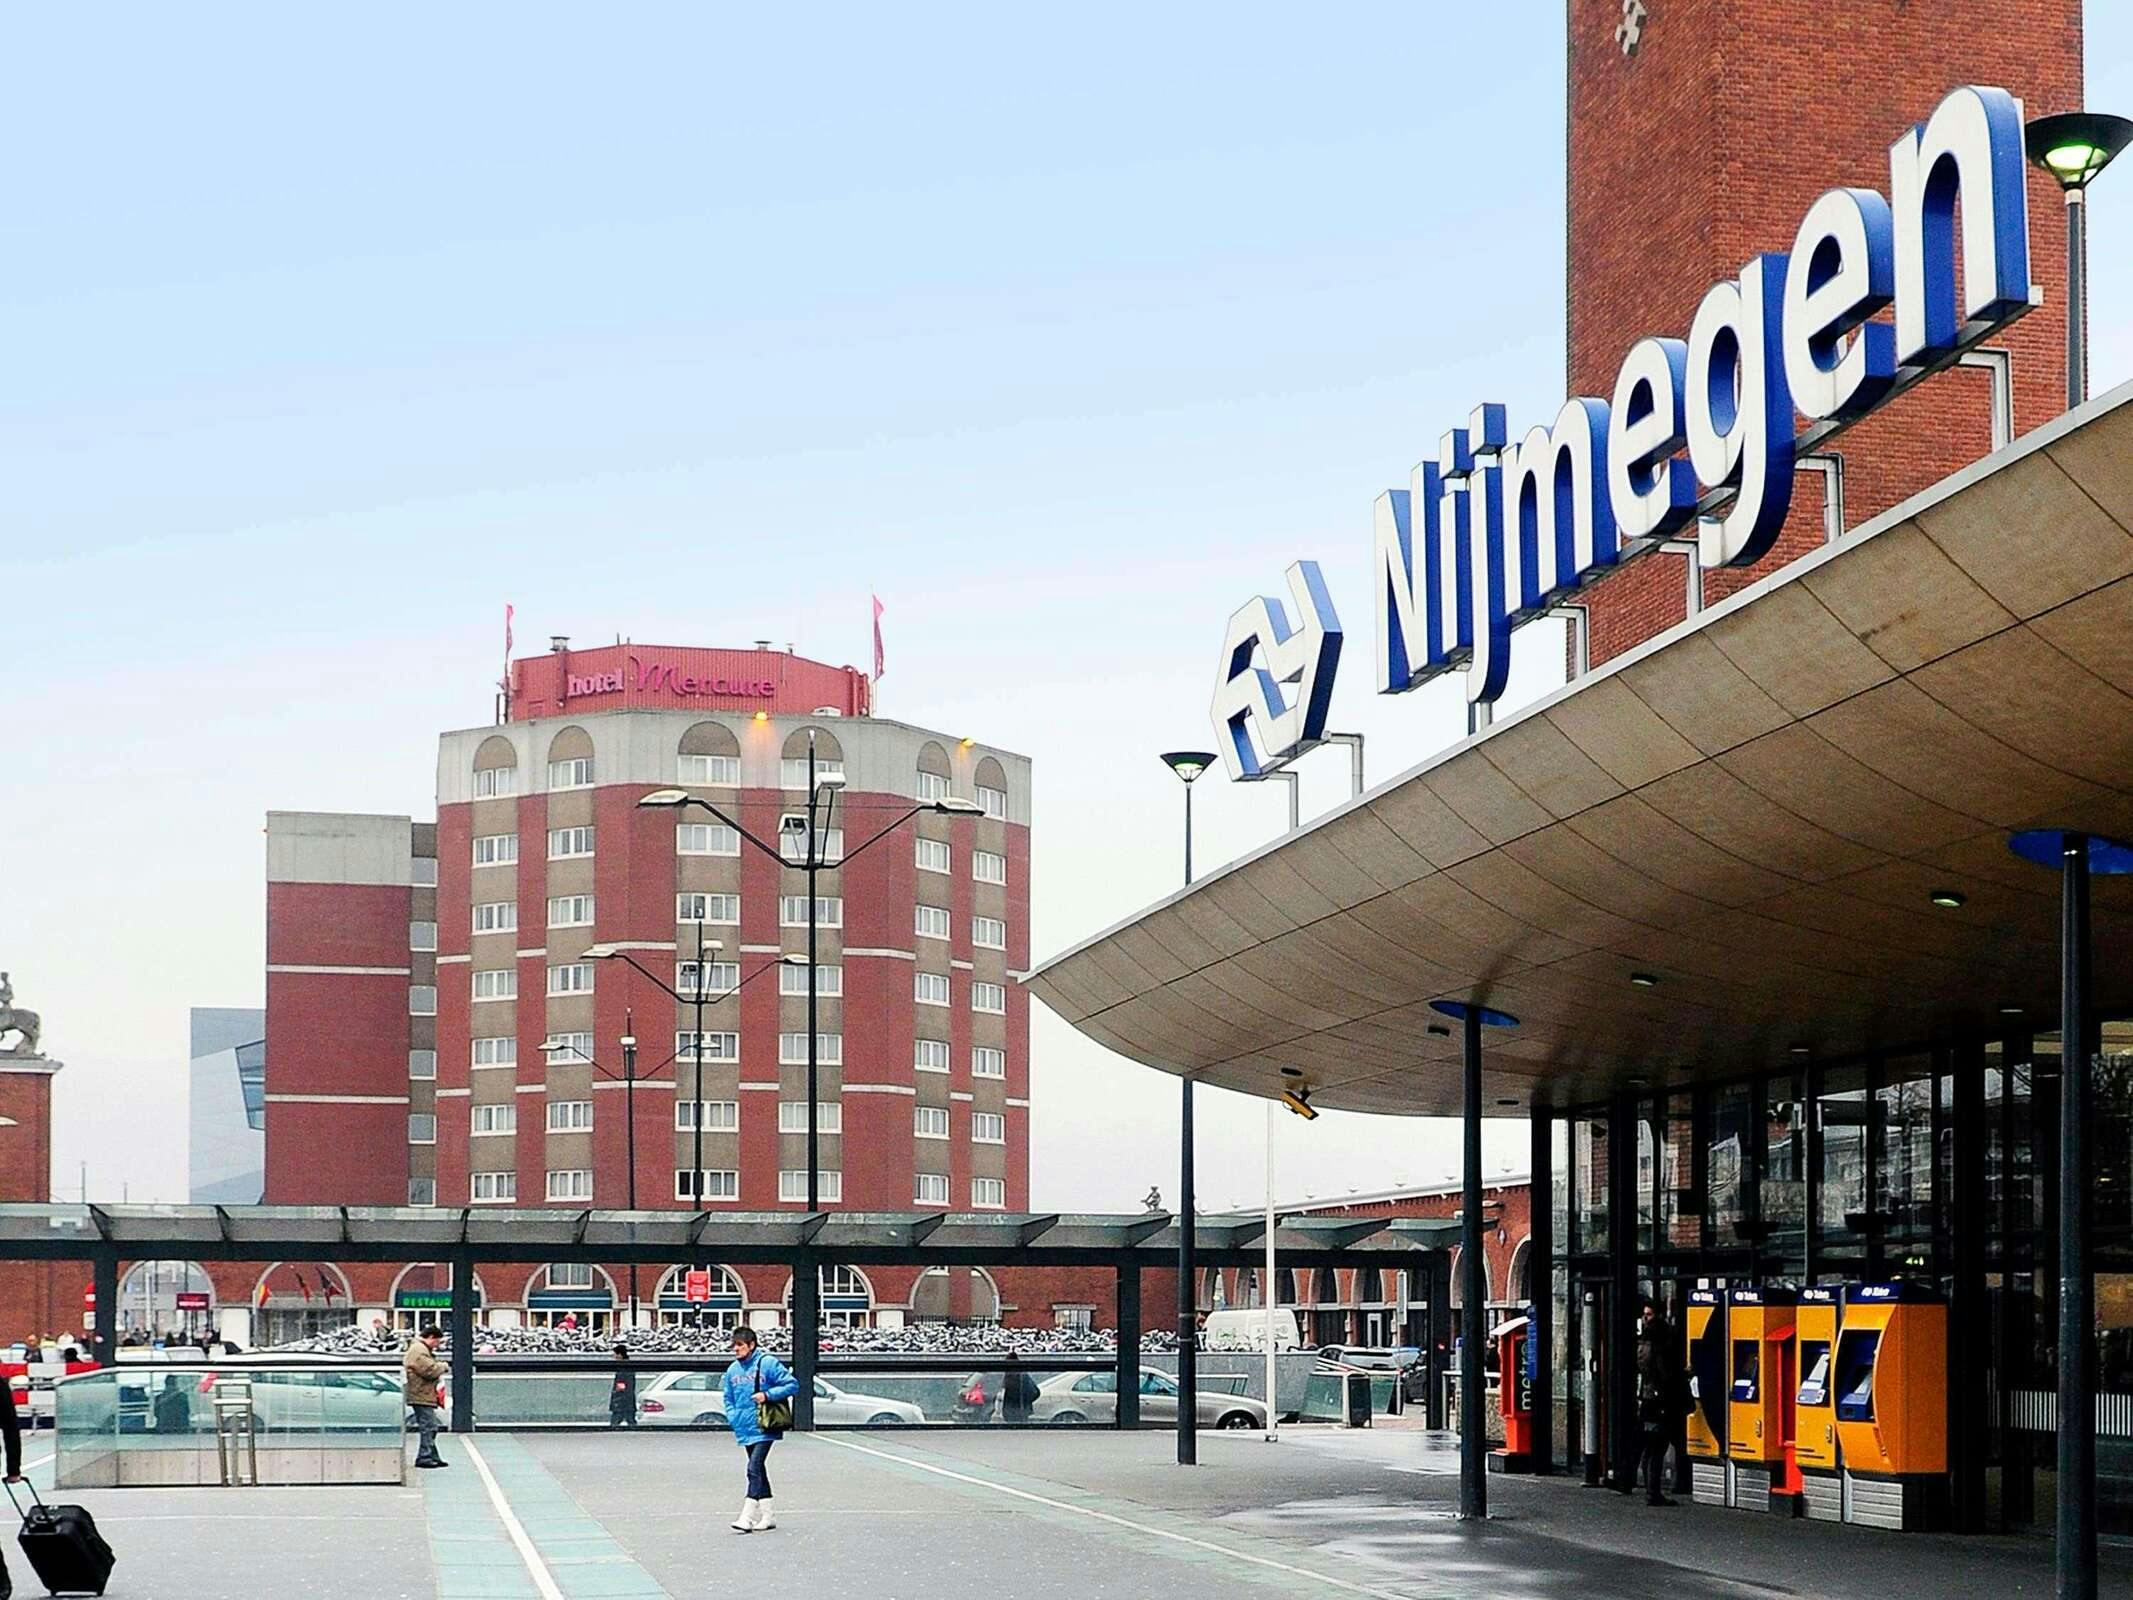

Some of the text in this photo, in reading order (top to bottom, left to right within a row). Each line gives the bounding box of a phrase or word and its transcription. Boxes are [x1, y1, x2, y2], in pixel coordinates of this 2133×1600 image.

[1374, 84, 2031, 704] Nijmegen
[568, 655, 775, 697] hotel Mercure
